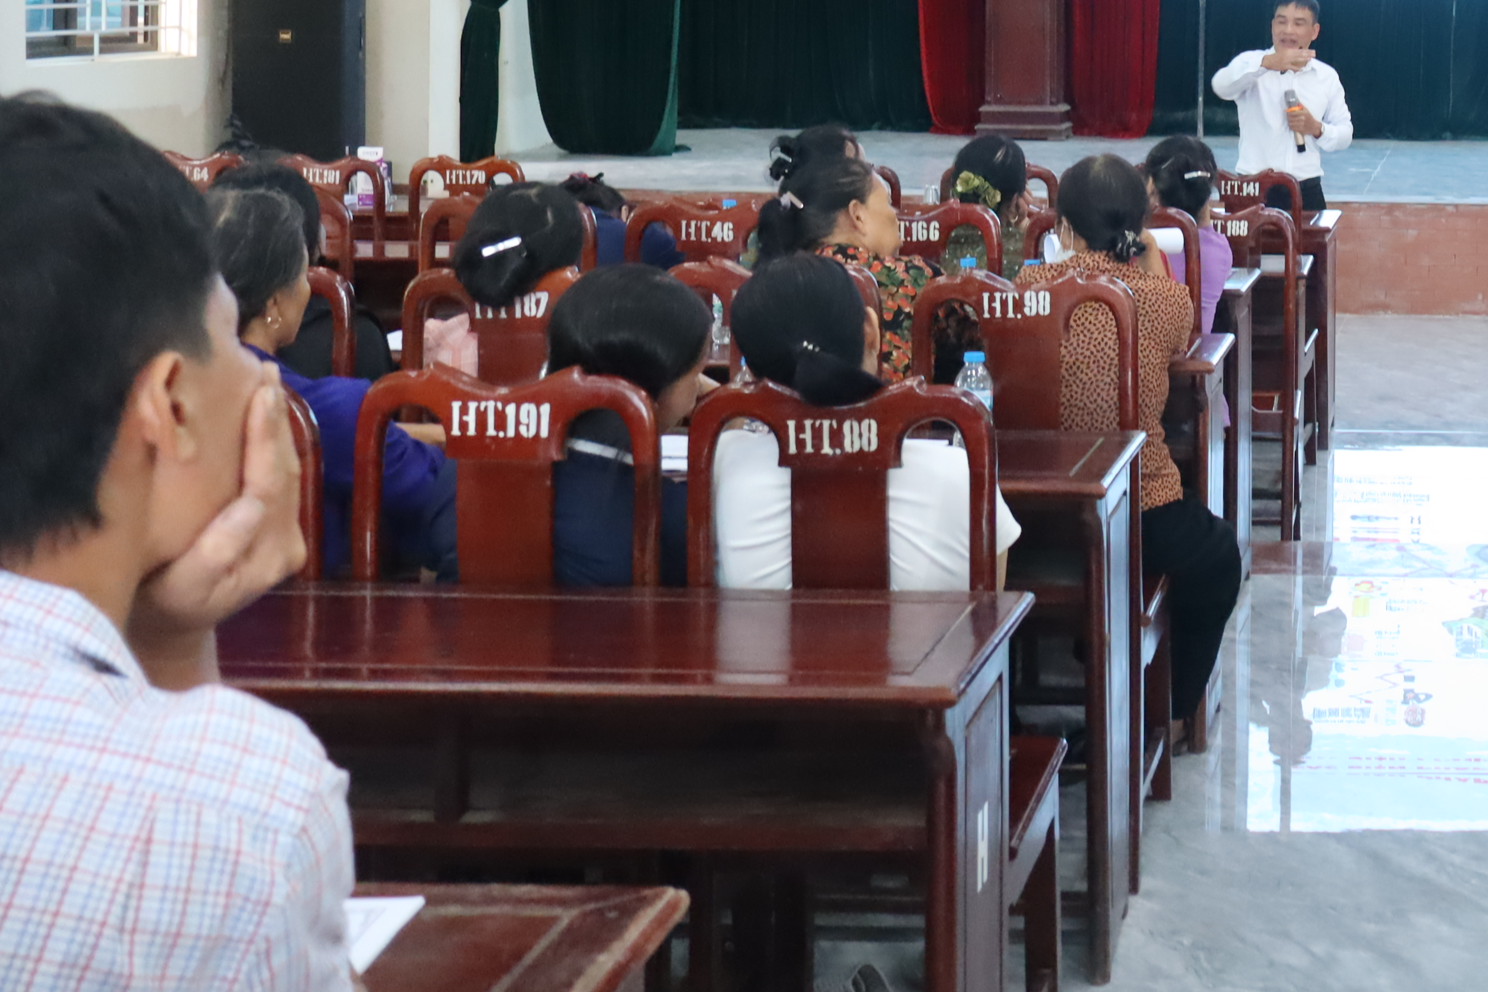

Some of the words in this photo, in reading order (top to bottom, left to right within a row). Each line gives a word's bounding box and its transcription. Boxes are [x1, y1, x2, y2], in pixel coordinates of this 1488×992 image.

[681, 220, 734, 243] HT.46
[900, 220, 940, 242] T.166
[451, 400, 551, 439] HT.191
